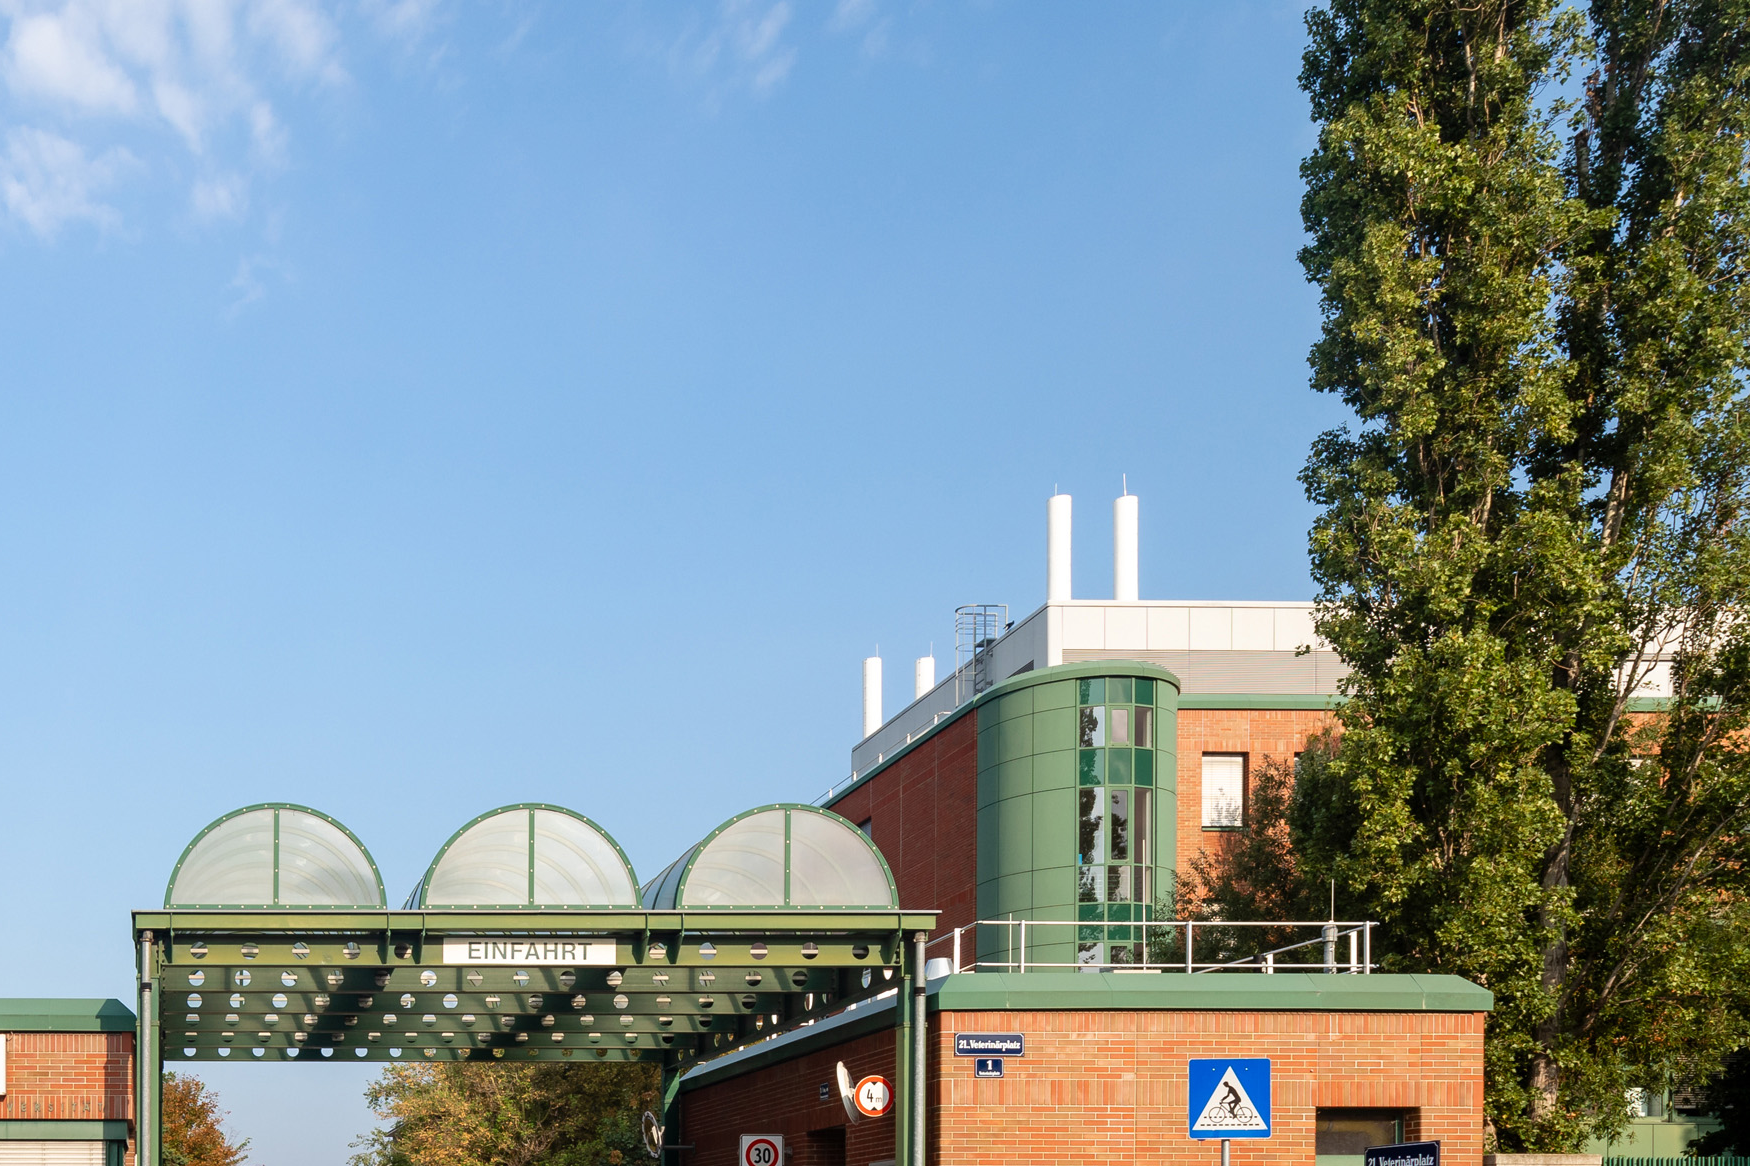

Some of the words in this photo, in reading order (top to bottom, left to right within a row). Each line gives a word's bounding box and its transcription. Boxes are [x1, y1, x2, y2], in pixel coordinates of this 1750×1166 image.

[467, 941, 593, 960] EINFAHRT
[986, 1060, 993, 1070] 1
[866, 1088, 874, 1103] 4
[753, 1147, 771, 1164] 30
